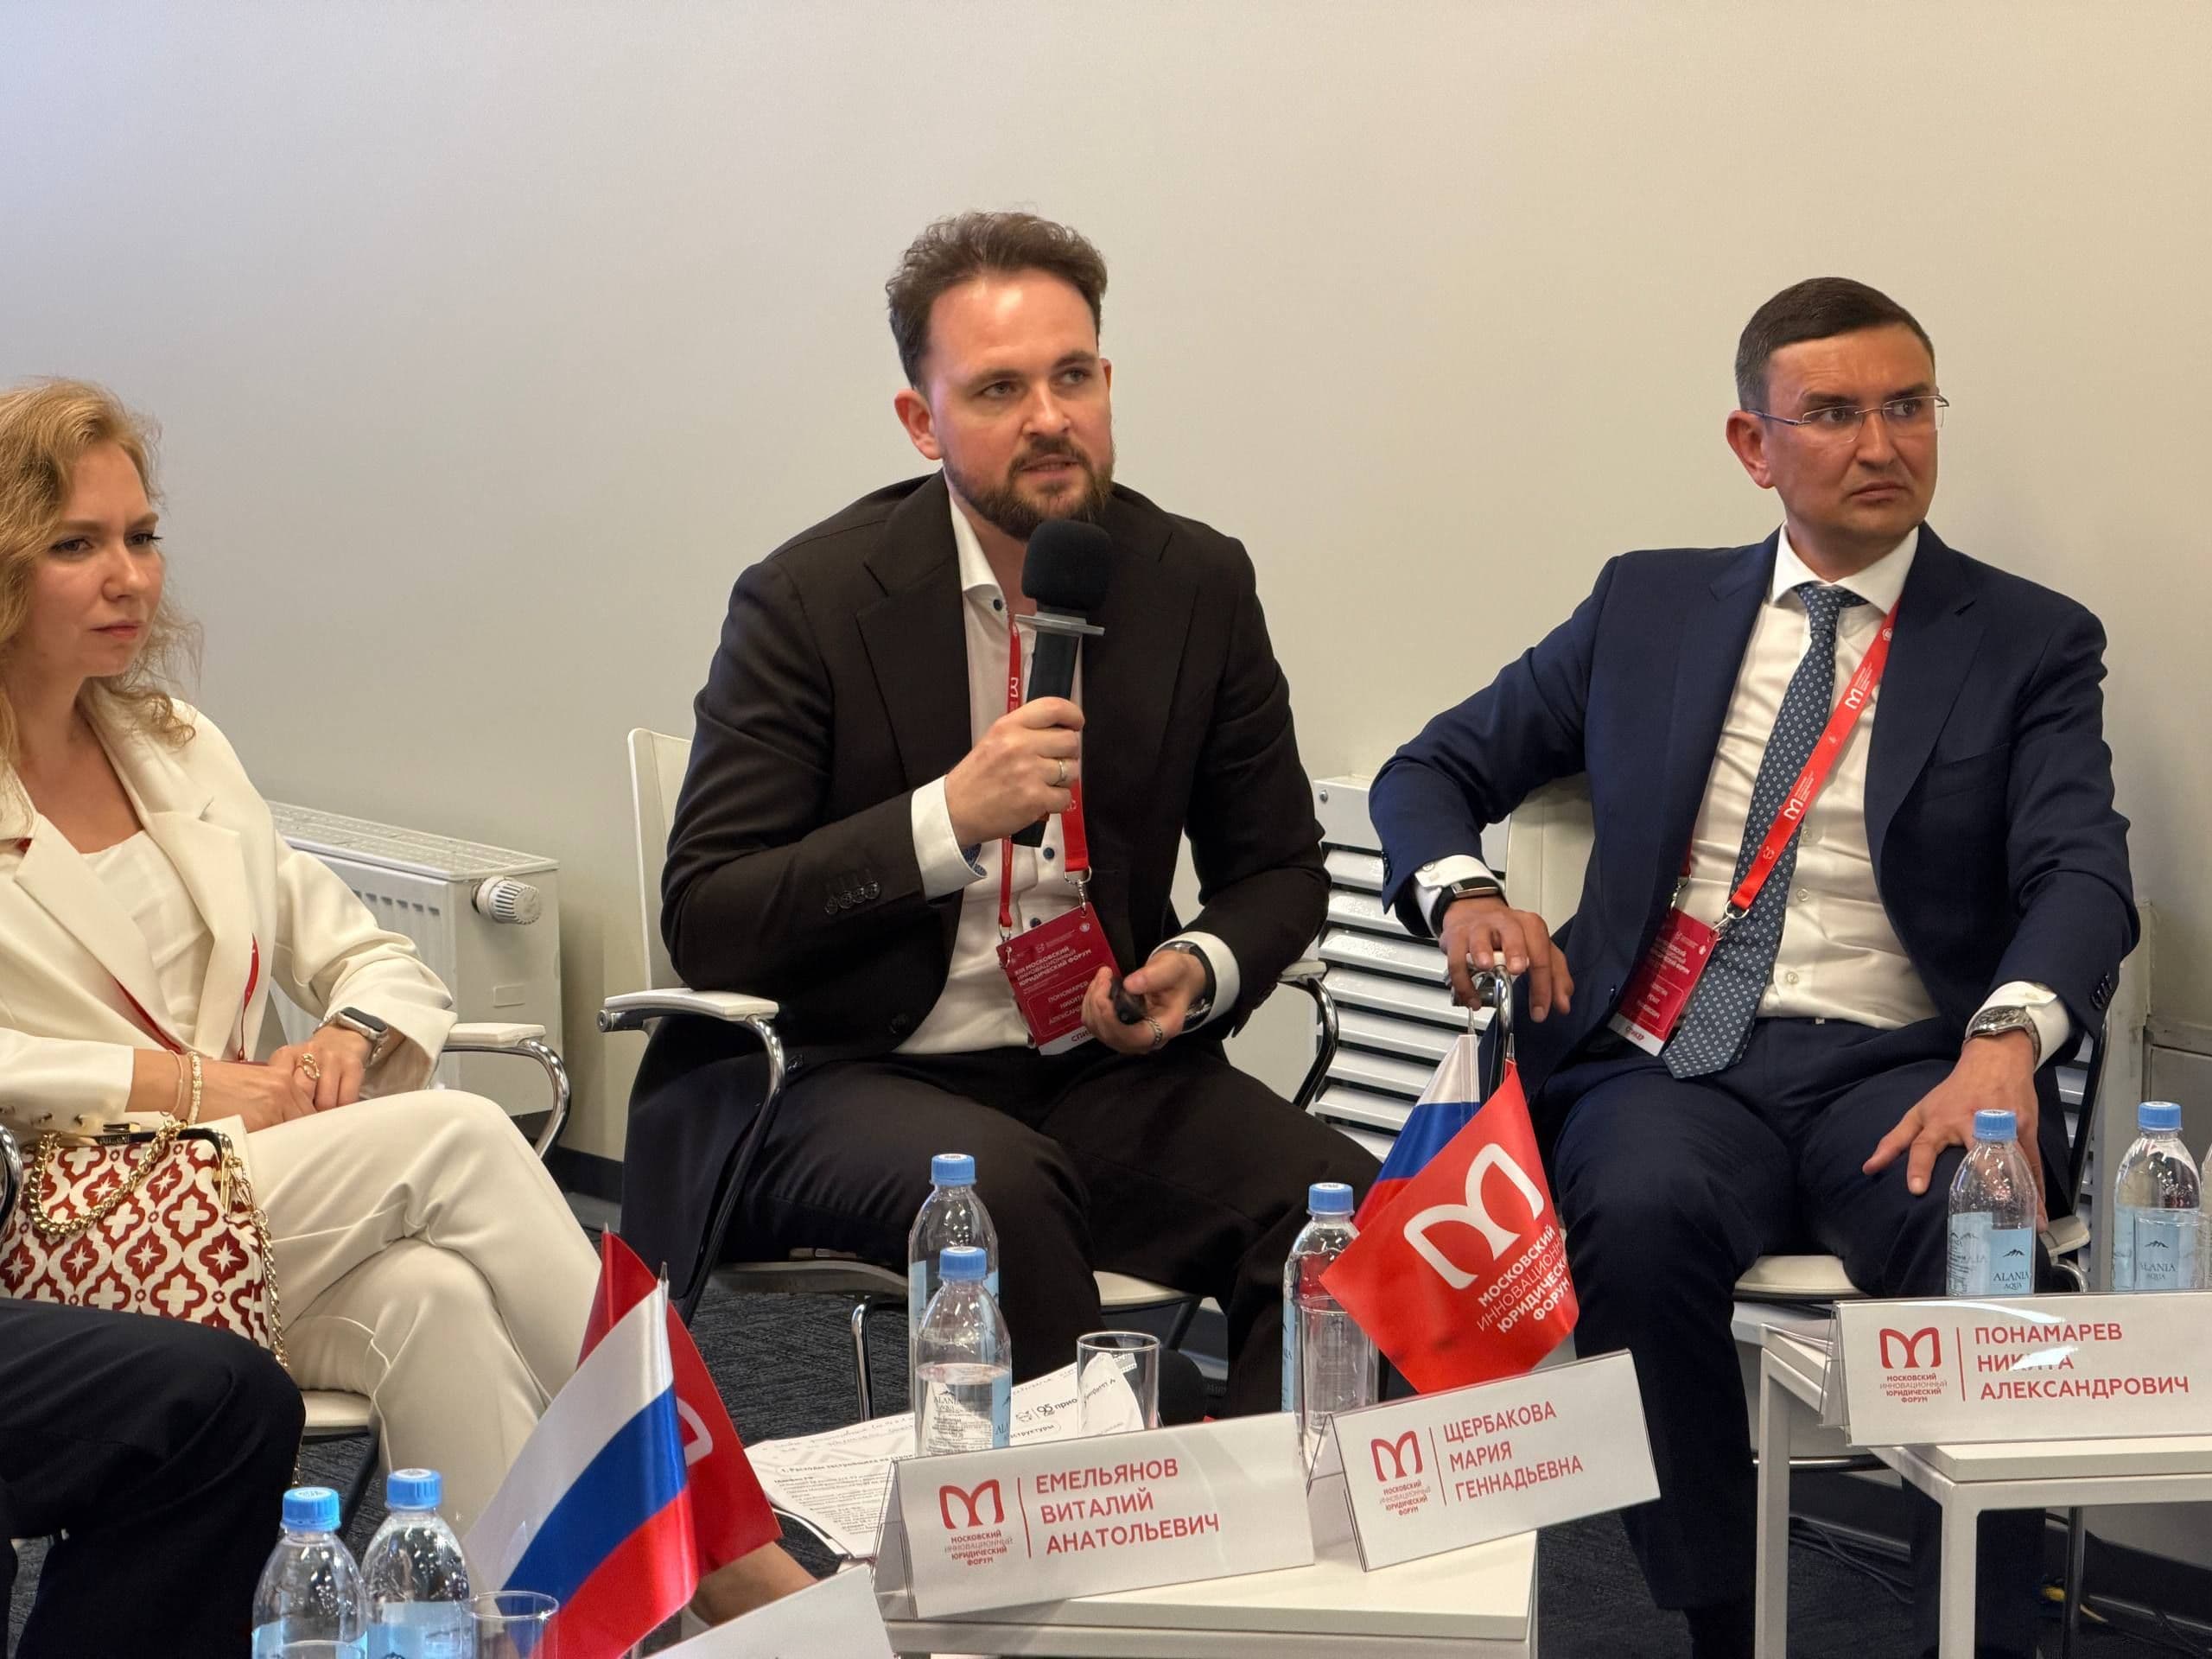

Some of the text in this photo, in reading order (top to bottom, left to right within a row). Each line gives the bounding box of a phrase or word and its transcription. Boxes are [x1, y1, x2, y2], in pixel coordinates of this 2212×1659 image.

[1478, 1224, 1555, 1307] МОСКОВСКИЙ
[1533, 1276, 1571, 1321] ФОРУМ
[1974, 1323, 2123, 1344] ПОНАМАРЕВ
[1886, 1372, 1937, 1382] МОСКОВСКИЙ
[1886, 1386, 1942, 1396] ЮРИДИЧЕСКИЙ
[1980, 1376, 2190, 1400] АЛЕКСАНДРОВИЧ
[1444, 1401, 1556, 1443] ЩЕРБАКОВА
[1449, 1441, 1512, 1472] МАРИЯ
[1036, 1459, 1178, 1494] ЕМЕЛЬЯНОВ
[1455, 1455, 1583, 1502] ГЕННАДЬЕВНА
[1040, 1487, 1154, 1524] ВИТАЛИЙ
[951, 1529, 1001, 1543] МОСКОВСКИЙ
[1046, 1513, 1220, 1554] АНАТОЛЬЕВИЧ
[951, 1543, 1007, 1560] ЮРИДИЧЕСКИЙ
[967, 1557, 994, 1566] ФОРУМ
